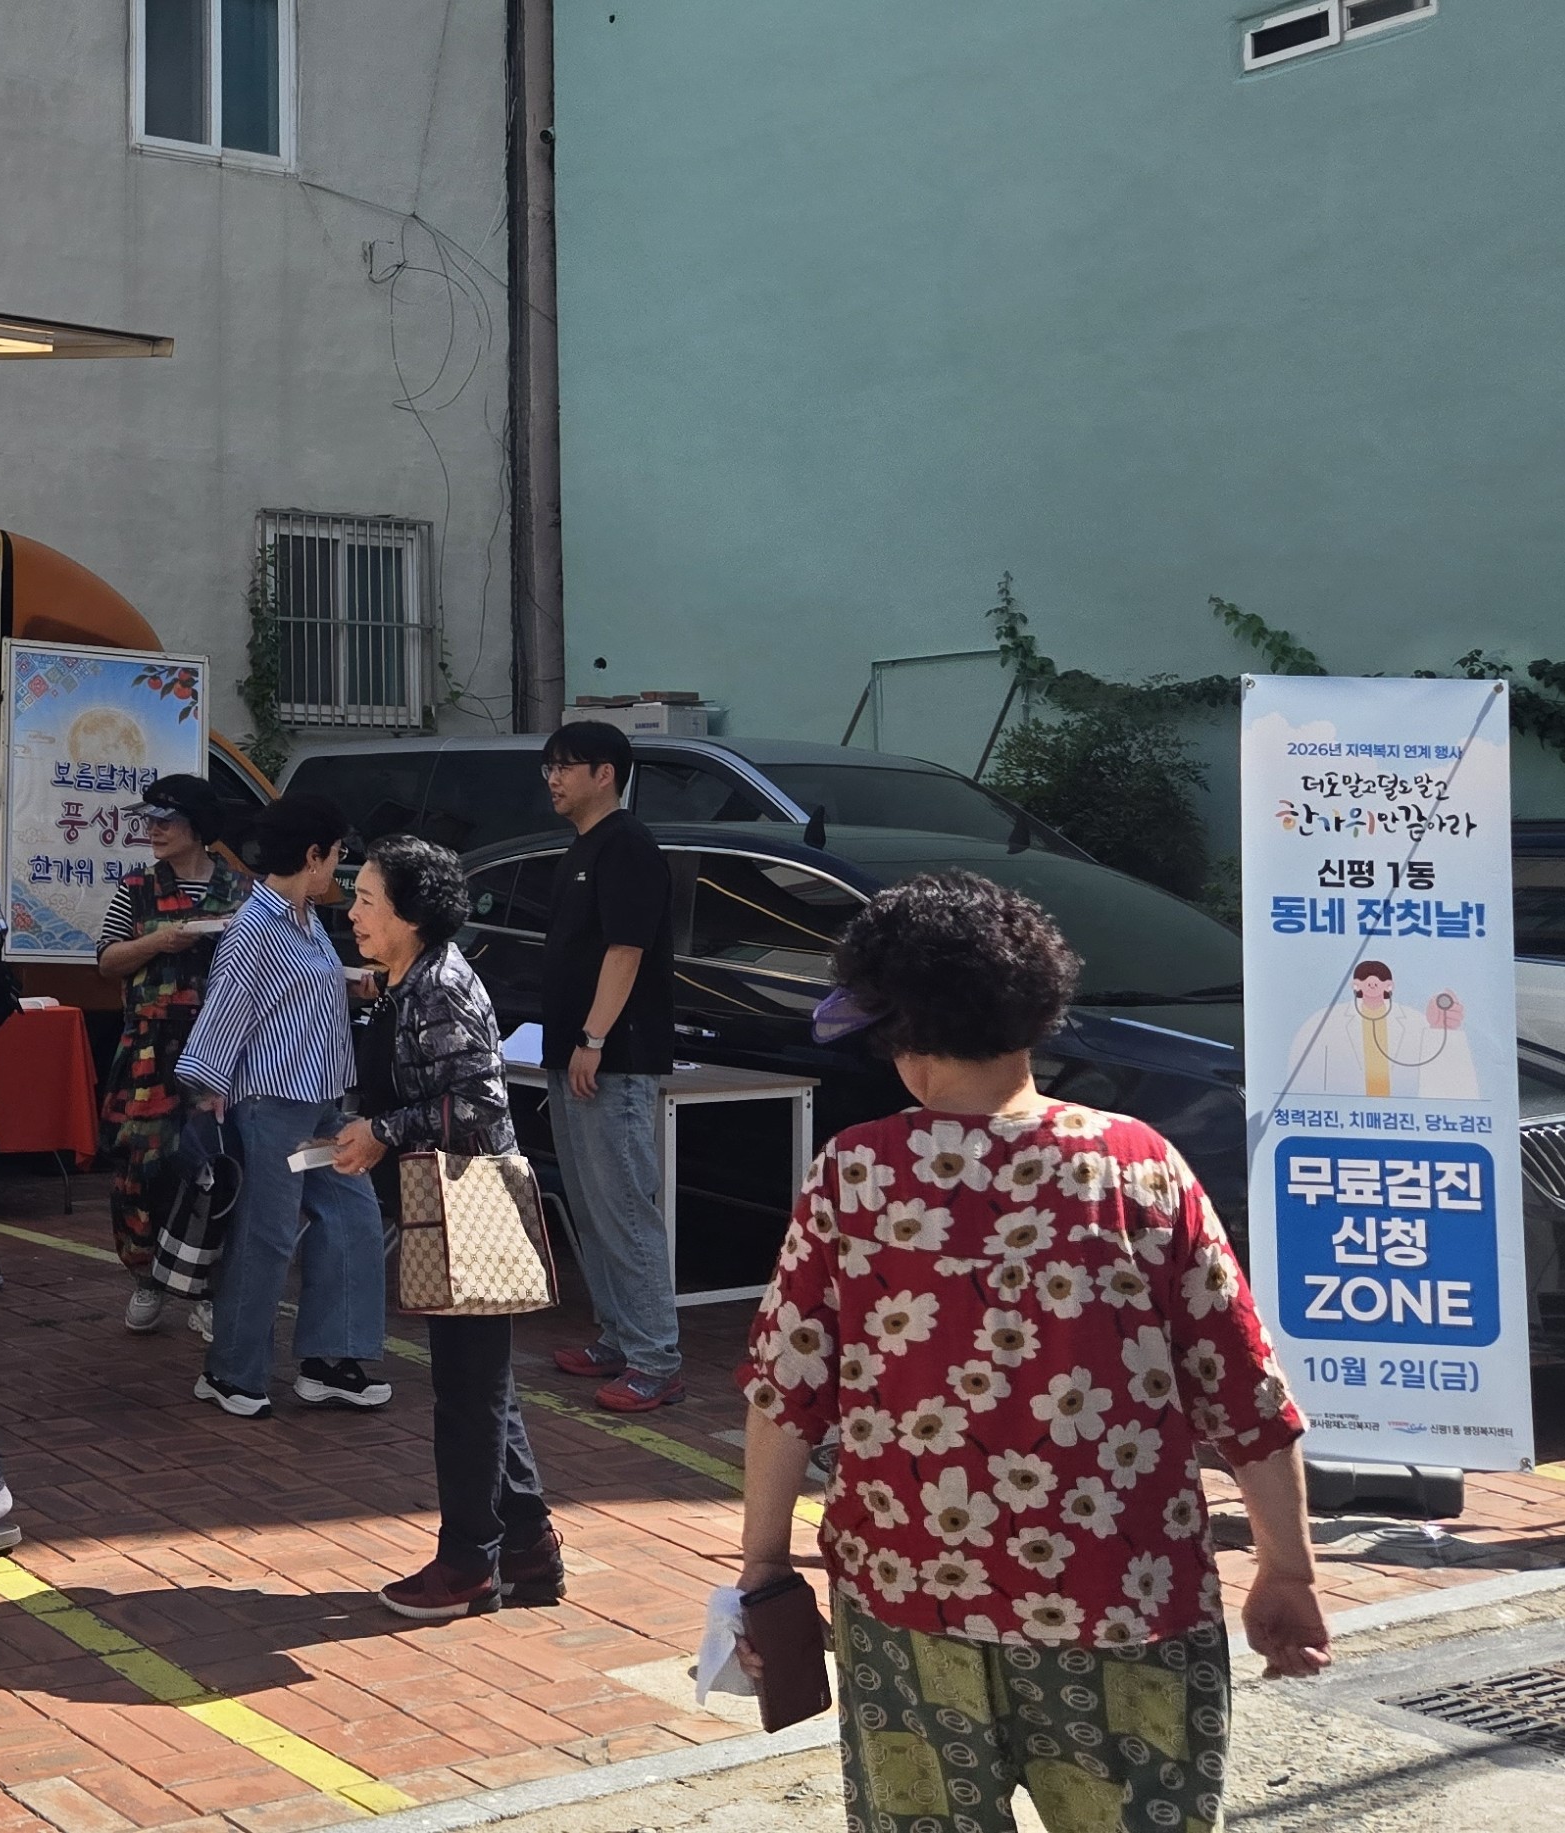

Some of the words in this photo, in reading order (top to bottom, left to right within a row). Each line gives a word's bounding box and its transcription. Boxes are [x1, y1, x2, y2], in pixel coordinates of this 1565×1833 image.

[1287, 742, 1342, 757] 2026년
[1345, 743, 1400, 758] 지역복지
[1403, 745, 1431, 759] 연계
[1435, 746, 1462, 760] 행사
[30, 856, 93, 884] 한가위
[1318, 859, 1374, 888] 신평
[1386, 861, 1435, 890] 1동
[1271, 896, 1345, 934] 동네
[1357, 898, 1486, 938] 잔칫날!
[1274, 1108, 1344, 1129] 청력검진,
[1349, 1111, 1420, 1132] 치매검진,
[1425, 1114, 1493, 1133] 당뇨검진
[1287, 1156, 1482, 1211] 무료검진
[1332, 1216, 1429, 1267] 신청
[1304, 1274, 1474, 1327] ZONE
[1303, 1357, 1367, 1386] 10월
[1379, 1360, 1480, 1393] 2일(금)
[1309, 1419, 1380, 1431] 평사랑채노인복지관
[1431, 1424, 1460, 1435] 신평1동
[1463, 1425, 1513, 1437] 행정복지센터
